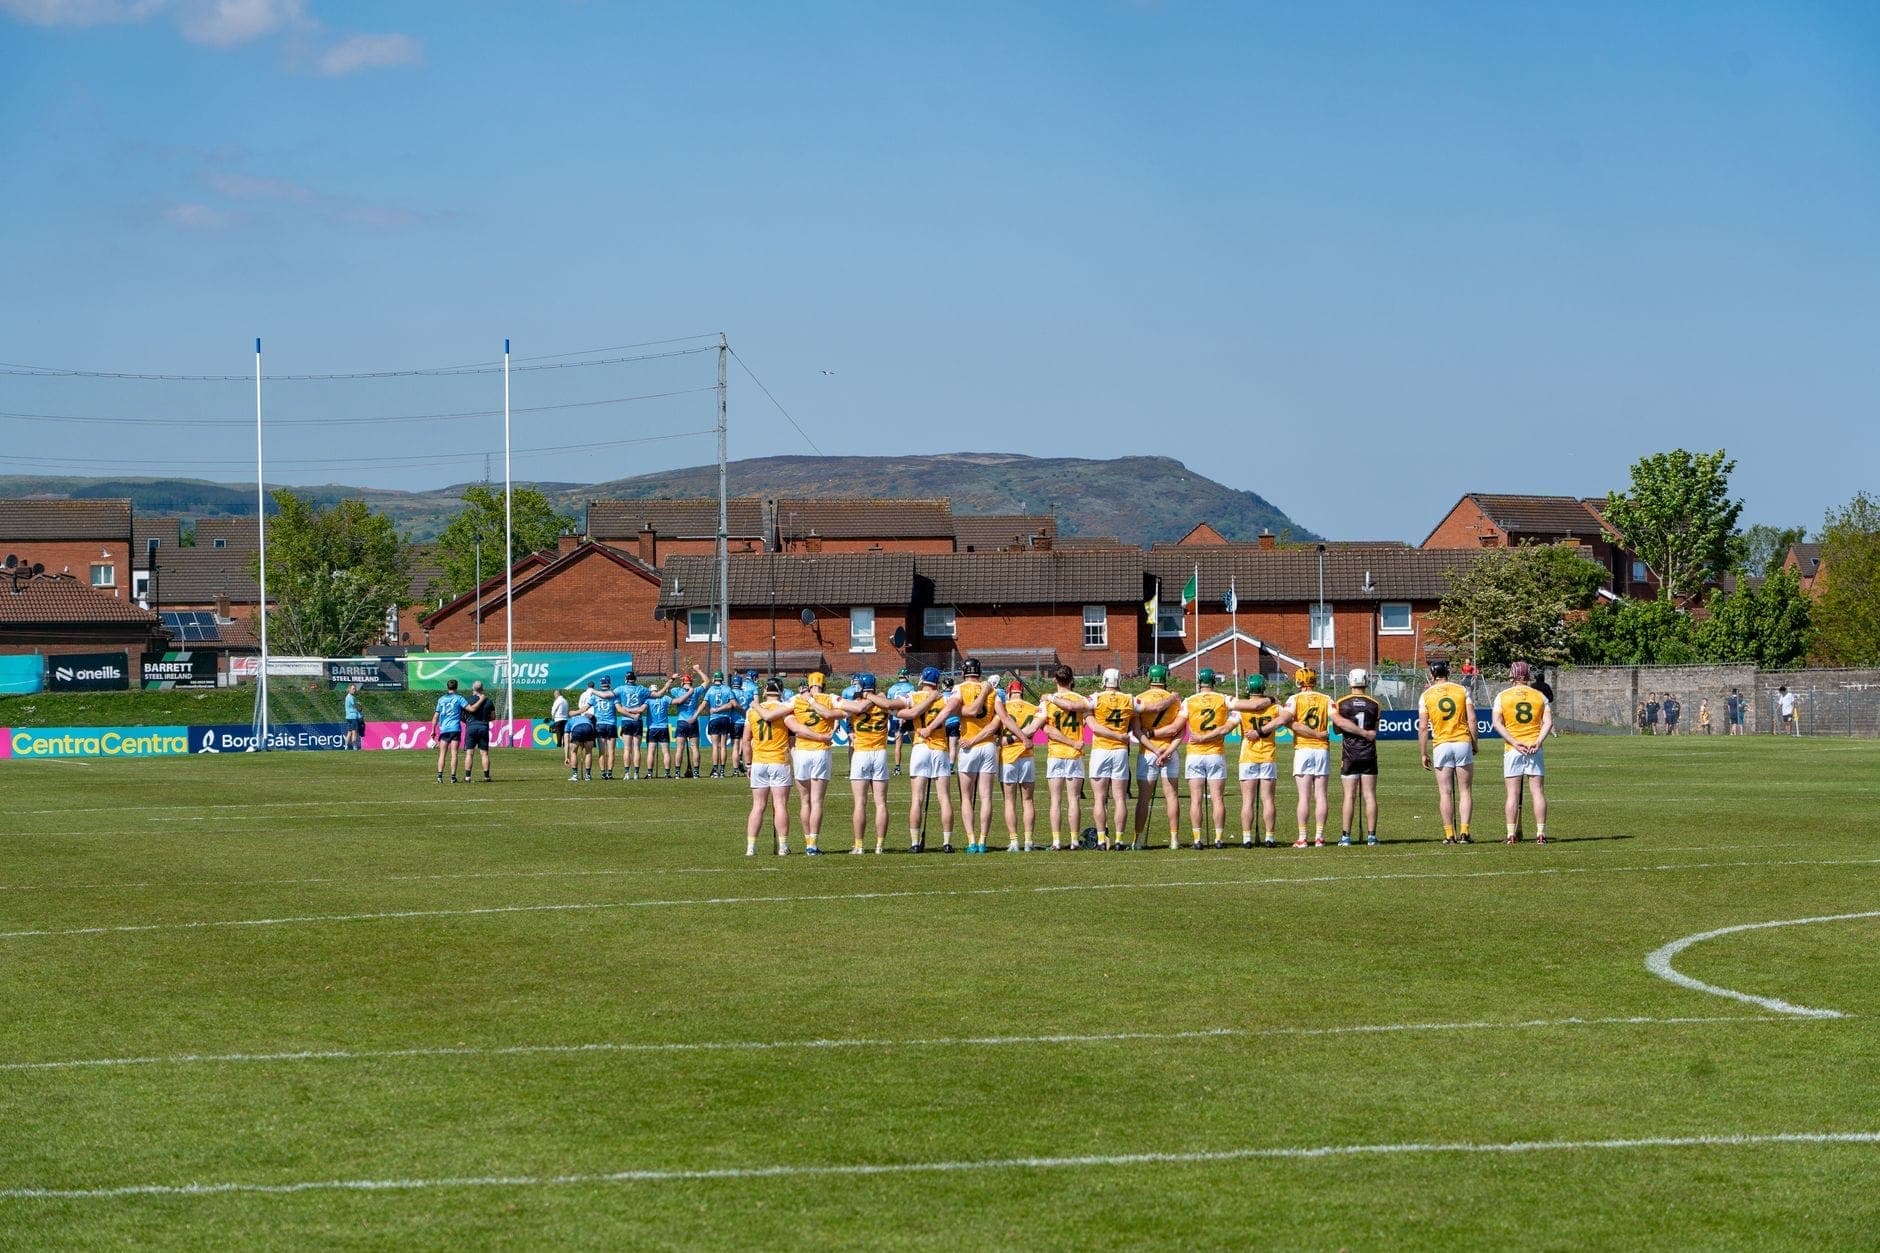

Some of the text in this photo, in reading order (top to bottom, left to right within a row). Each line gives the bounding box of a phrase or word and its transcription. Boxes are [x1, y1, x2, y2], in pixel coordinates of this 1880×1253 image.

[144, 663, 193, 672] BARRETT
[332, 666, 379, 675] BARRETT
[1105, 709, 1123, 728] 4
[1200, 708, 1217, 730] 2
[1304, 706, 1320, 729] 6
[1355, 711, 1365, 729] 1
[1438, 697, 1456, 721] 9
[1515, 702, 1533, 724] 8
[757, 718, 773, 741] 11
[1053, 710, 1079, 733] 14
[1379, 718, 1412, 732] Bord
[12, 732, 99, 755] Centra
[101, 732, 188, 754] Centra
[222, 734, 260, 747] Bord
